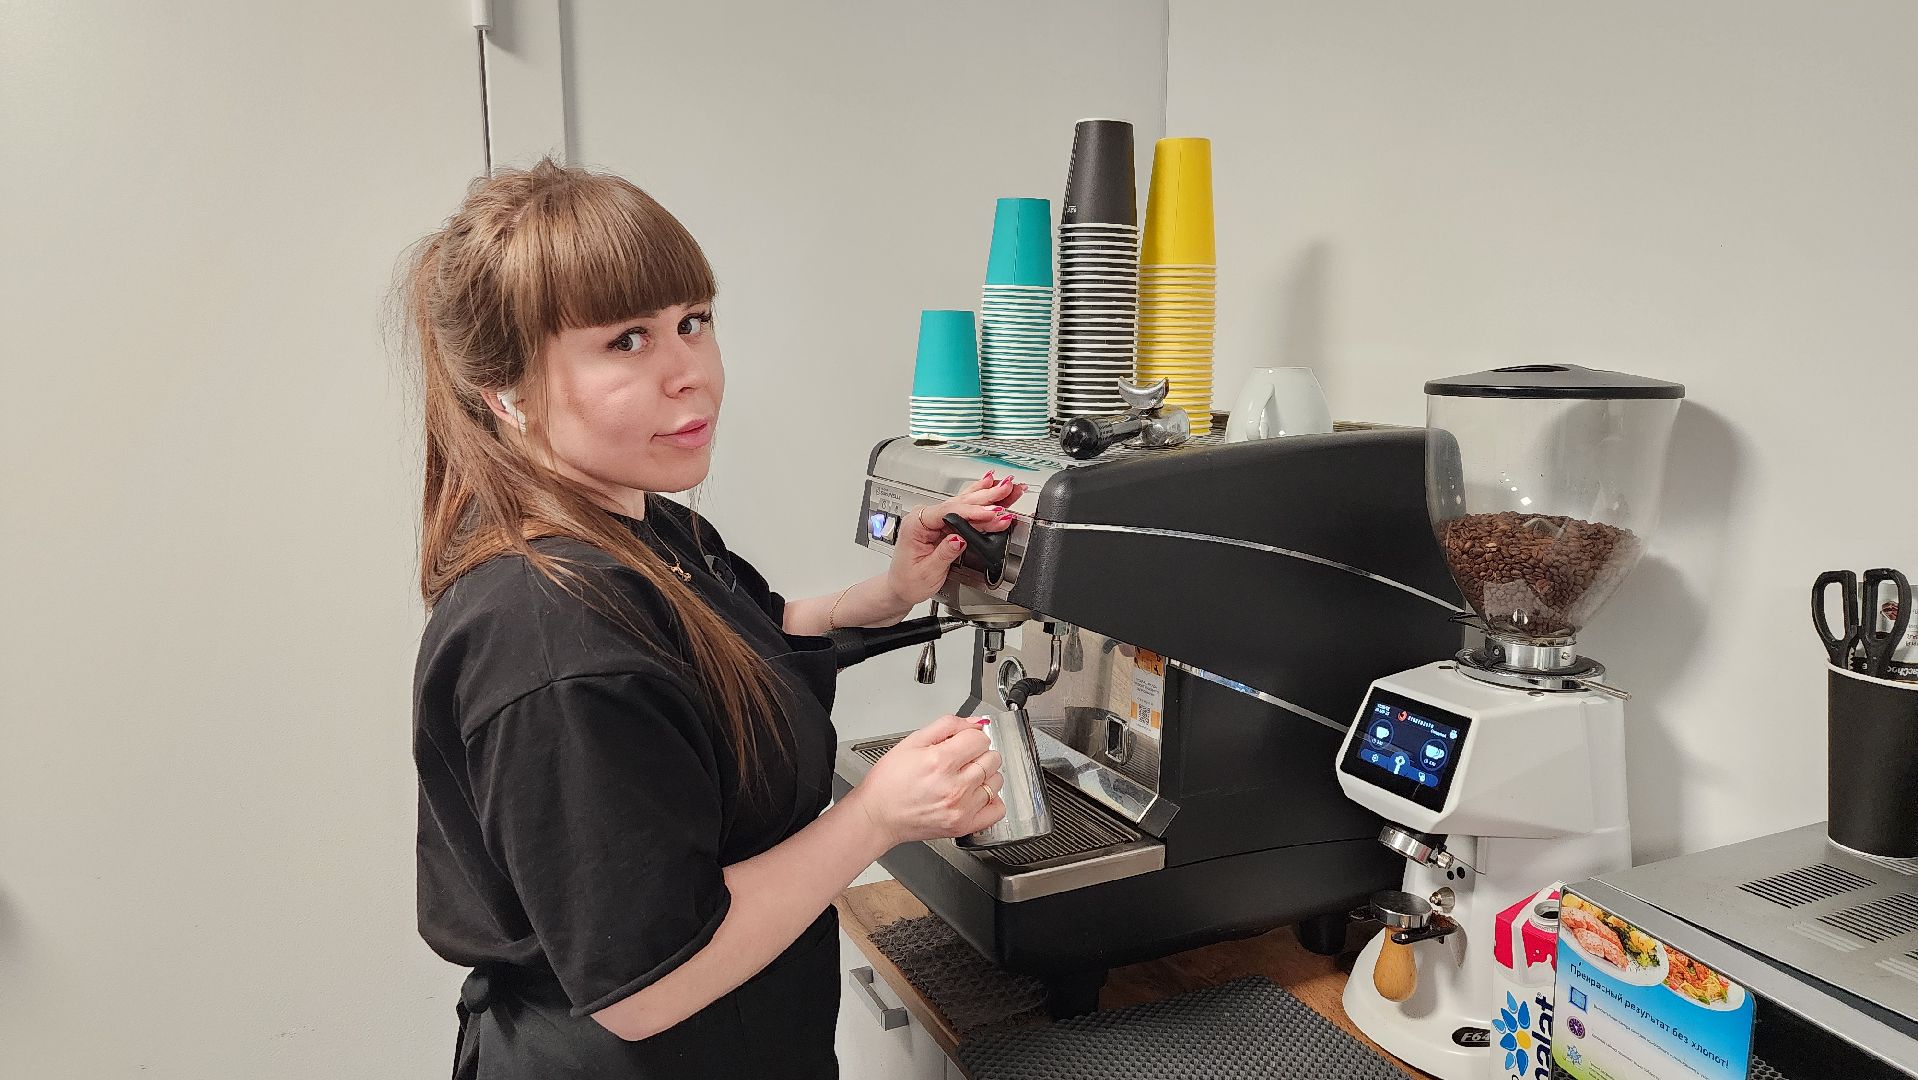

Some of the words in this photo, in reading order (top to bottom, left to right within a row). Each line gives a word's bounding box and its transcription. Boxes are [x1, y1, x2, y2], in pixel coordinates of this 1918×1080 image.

[1570, 963, 1623, 1003] Прекрасный
[1624, 1000, 1670, 1032] результат
[1672, 1027, 1689, 1044] без
[1691, 1040, 1729, 1069] хлопот!
